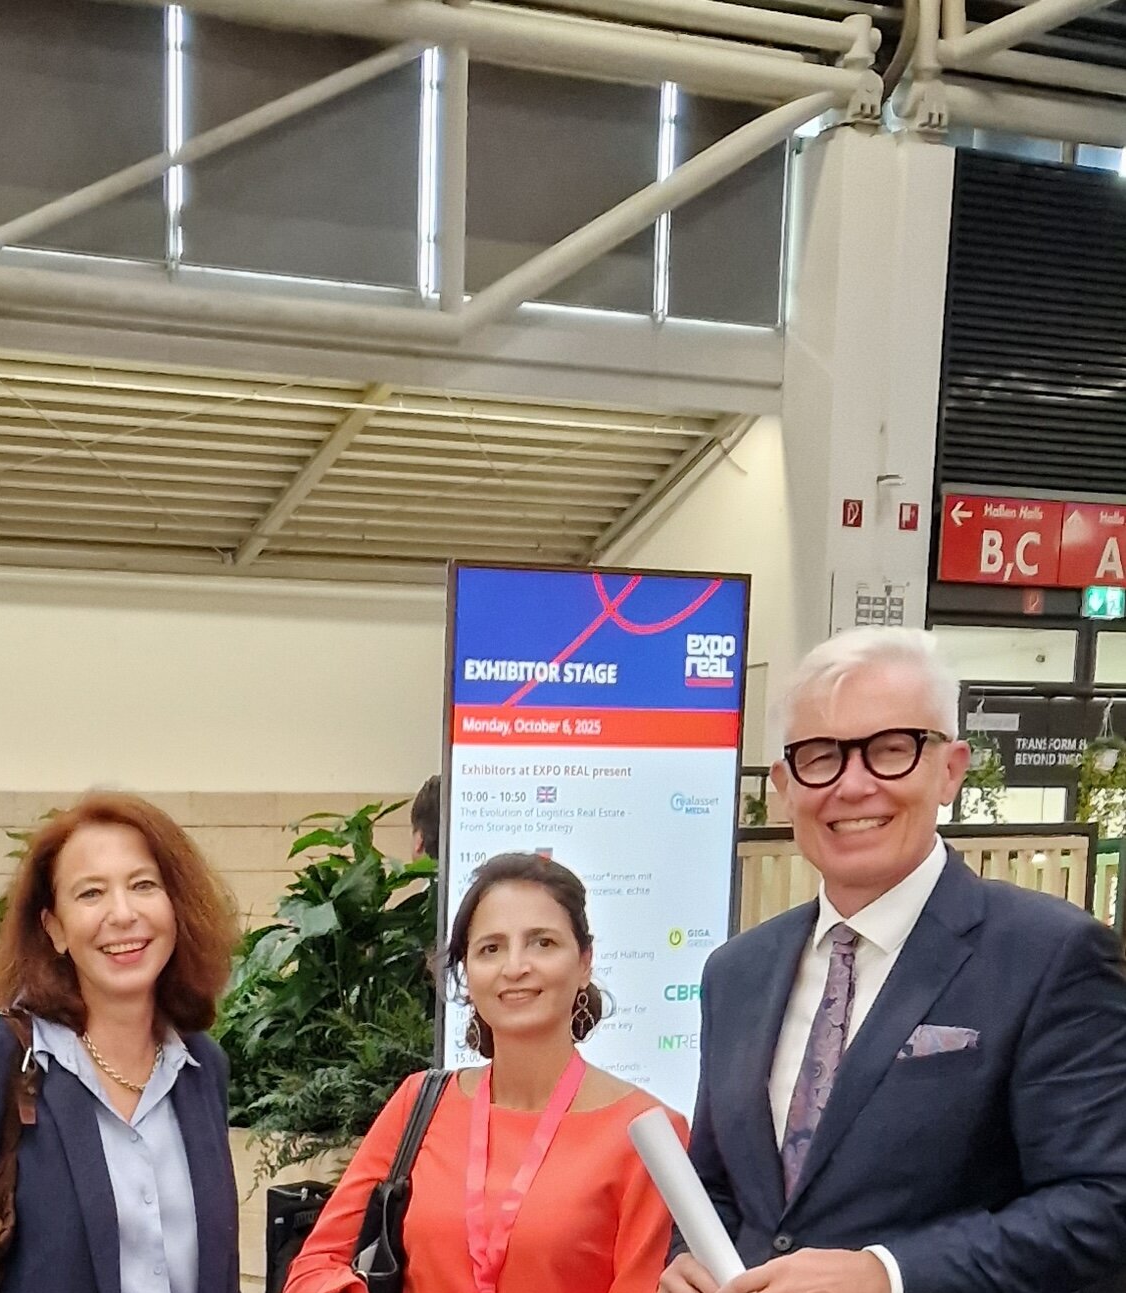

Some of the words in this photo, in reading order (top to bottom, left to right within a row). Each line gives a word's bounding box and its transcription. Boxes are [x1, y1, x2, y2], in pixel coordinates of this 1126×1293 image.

[984, 503, 1016, 518] Hallen
[980, 529, 1041, 582] B,C
[1095, 536, 1125, 579] A
[464, 659, 560, 683] EXHIBITOR
[563, 662, 618, 684] STAGE
[462, 717, 512, 736] Monday,
[514, 718, 560, 733] October
[561, 720, 573, 735] 6,
[574, 719, 602, 735] 2025
[1015, 753, 1056, 766] BEYOND
[461, 764, 516, 776] Exhibitors
[519, 767, 530, 776] at
[533, 765, 561, 776] EXPO
[564, 766, 589, 777] REAL
[592, 767, 632, 780] present
[461, 791, 488, 802] 10:00
[500, 792, 527, 803] 10:50
[460, 808, 477, 817] The
[479, 808, 523, 818] Evolution
[525, 808, 534, 818] of
[536, 808, 575, 820] Logistics
[577, 808, 596, 818] Real
[598, 809, 625, 818] Estate
[685, 806, 710, 815] MEDIA
[460, 823, 484, 833] From
[487, 823, 522, 835] Storage
[525, 824, 533, 833] to
[536, 823, 574, 835] Strategy
[687, 929, 711, 938] GIGA
[658, 1033, 698, 1050] INTRE
